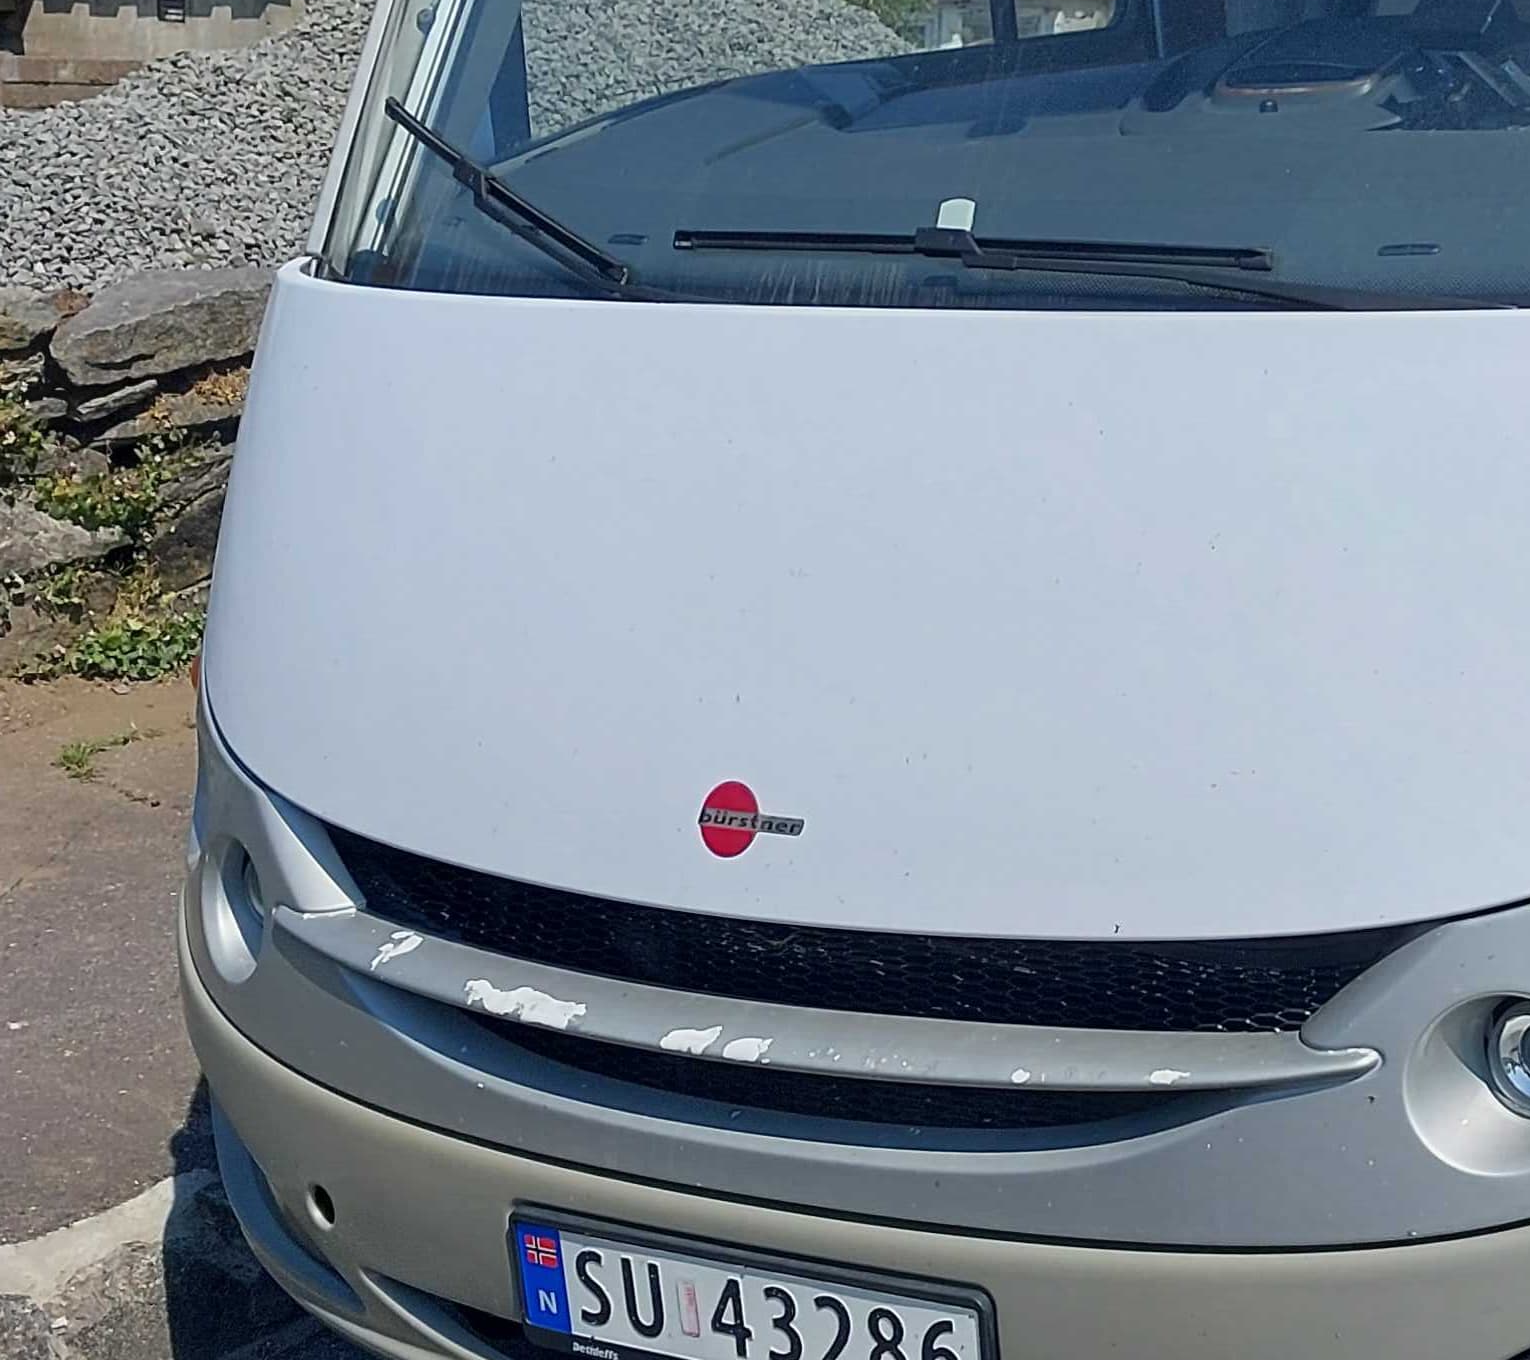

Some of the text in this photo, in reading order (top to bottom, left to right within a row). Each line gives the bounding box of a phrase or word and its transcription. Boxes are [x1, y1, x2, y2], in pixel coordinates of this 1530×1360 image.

[699, 809, 802, 834] bürstner
[539, 1289, 558, 1315] N
[576, 1248, 665, 1338] SU
